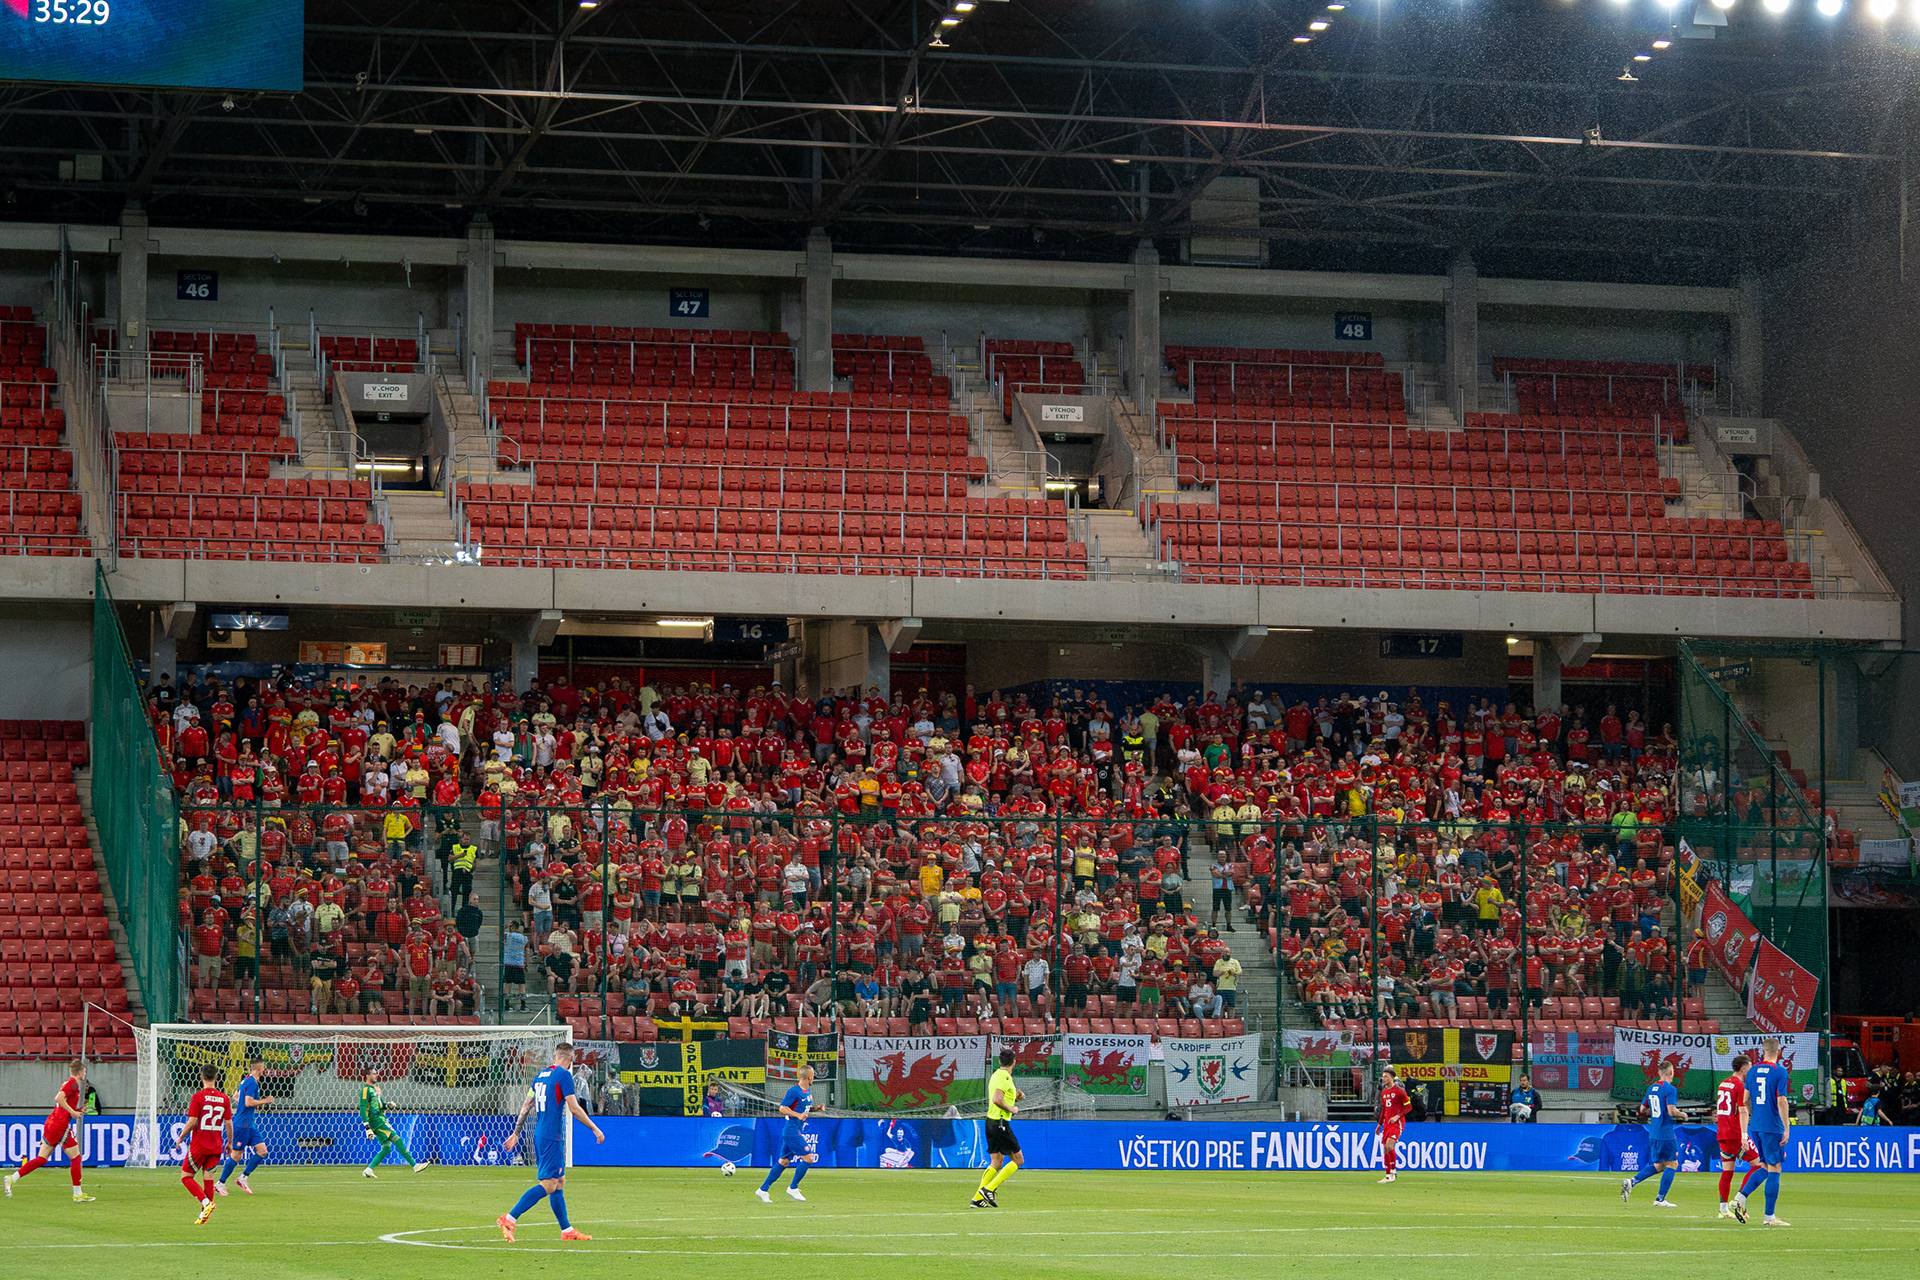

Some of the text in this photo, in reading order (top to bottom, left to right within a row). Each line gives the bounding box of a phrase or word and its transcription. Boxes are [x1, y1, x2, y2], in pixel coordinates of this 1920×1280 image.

[35, 0, 110, 25] 35:29
[185, 283, 210, 298] 46
[678, 300, 701, 315] 47
[1342, 323, 1365, 338] 48
[371, 385, 401, 393] VCHOD
[739, 623, 763, 639] 16
[1417, 638, 1440, 654] 17
[1689, 883, 1703, 898] QUAY
[852, 1037, 978, 1050] LLANFAIR BOYS
[1068, 1037, 1145, 1048] RHOSESMOR
[1170, 1040, 1245, 1052] CARDIFF CITY
[1619, 1029, 1711, 1048] WELSHPOOL
[1734, 1034, 1795, 1045] ELY VAY FC
[774, 1050, 832, 1060] TAFFS WELL
[1539, 1055, 1605, 1065] COLWYN BAY
[685, 1044, 700, 1114] SPARROW
[1400, 1066, 1437, 1078] RHOS
[1462, 1067, 1489, 1078] SEA
[535, 1082, 547, 1112] 14
[1756, 1077, 1767, 1104] 3
[1648, 1094, 1662, 1118] 19
[1717, 1090, 1731, 1115] 23
[200, 1104, 226, 1131] 22
[1118, 1124, 1488, 1169] VŠETKO PRE FANÚŠIKA SOKOLOV
[1797, 1136, 1870, 1168] NÁJDEŠ
[1875, 1142, 1902, 1168] NA
